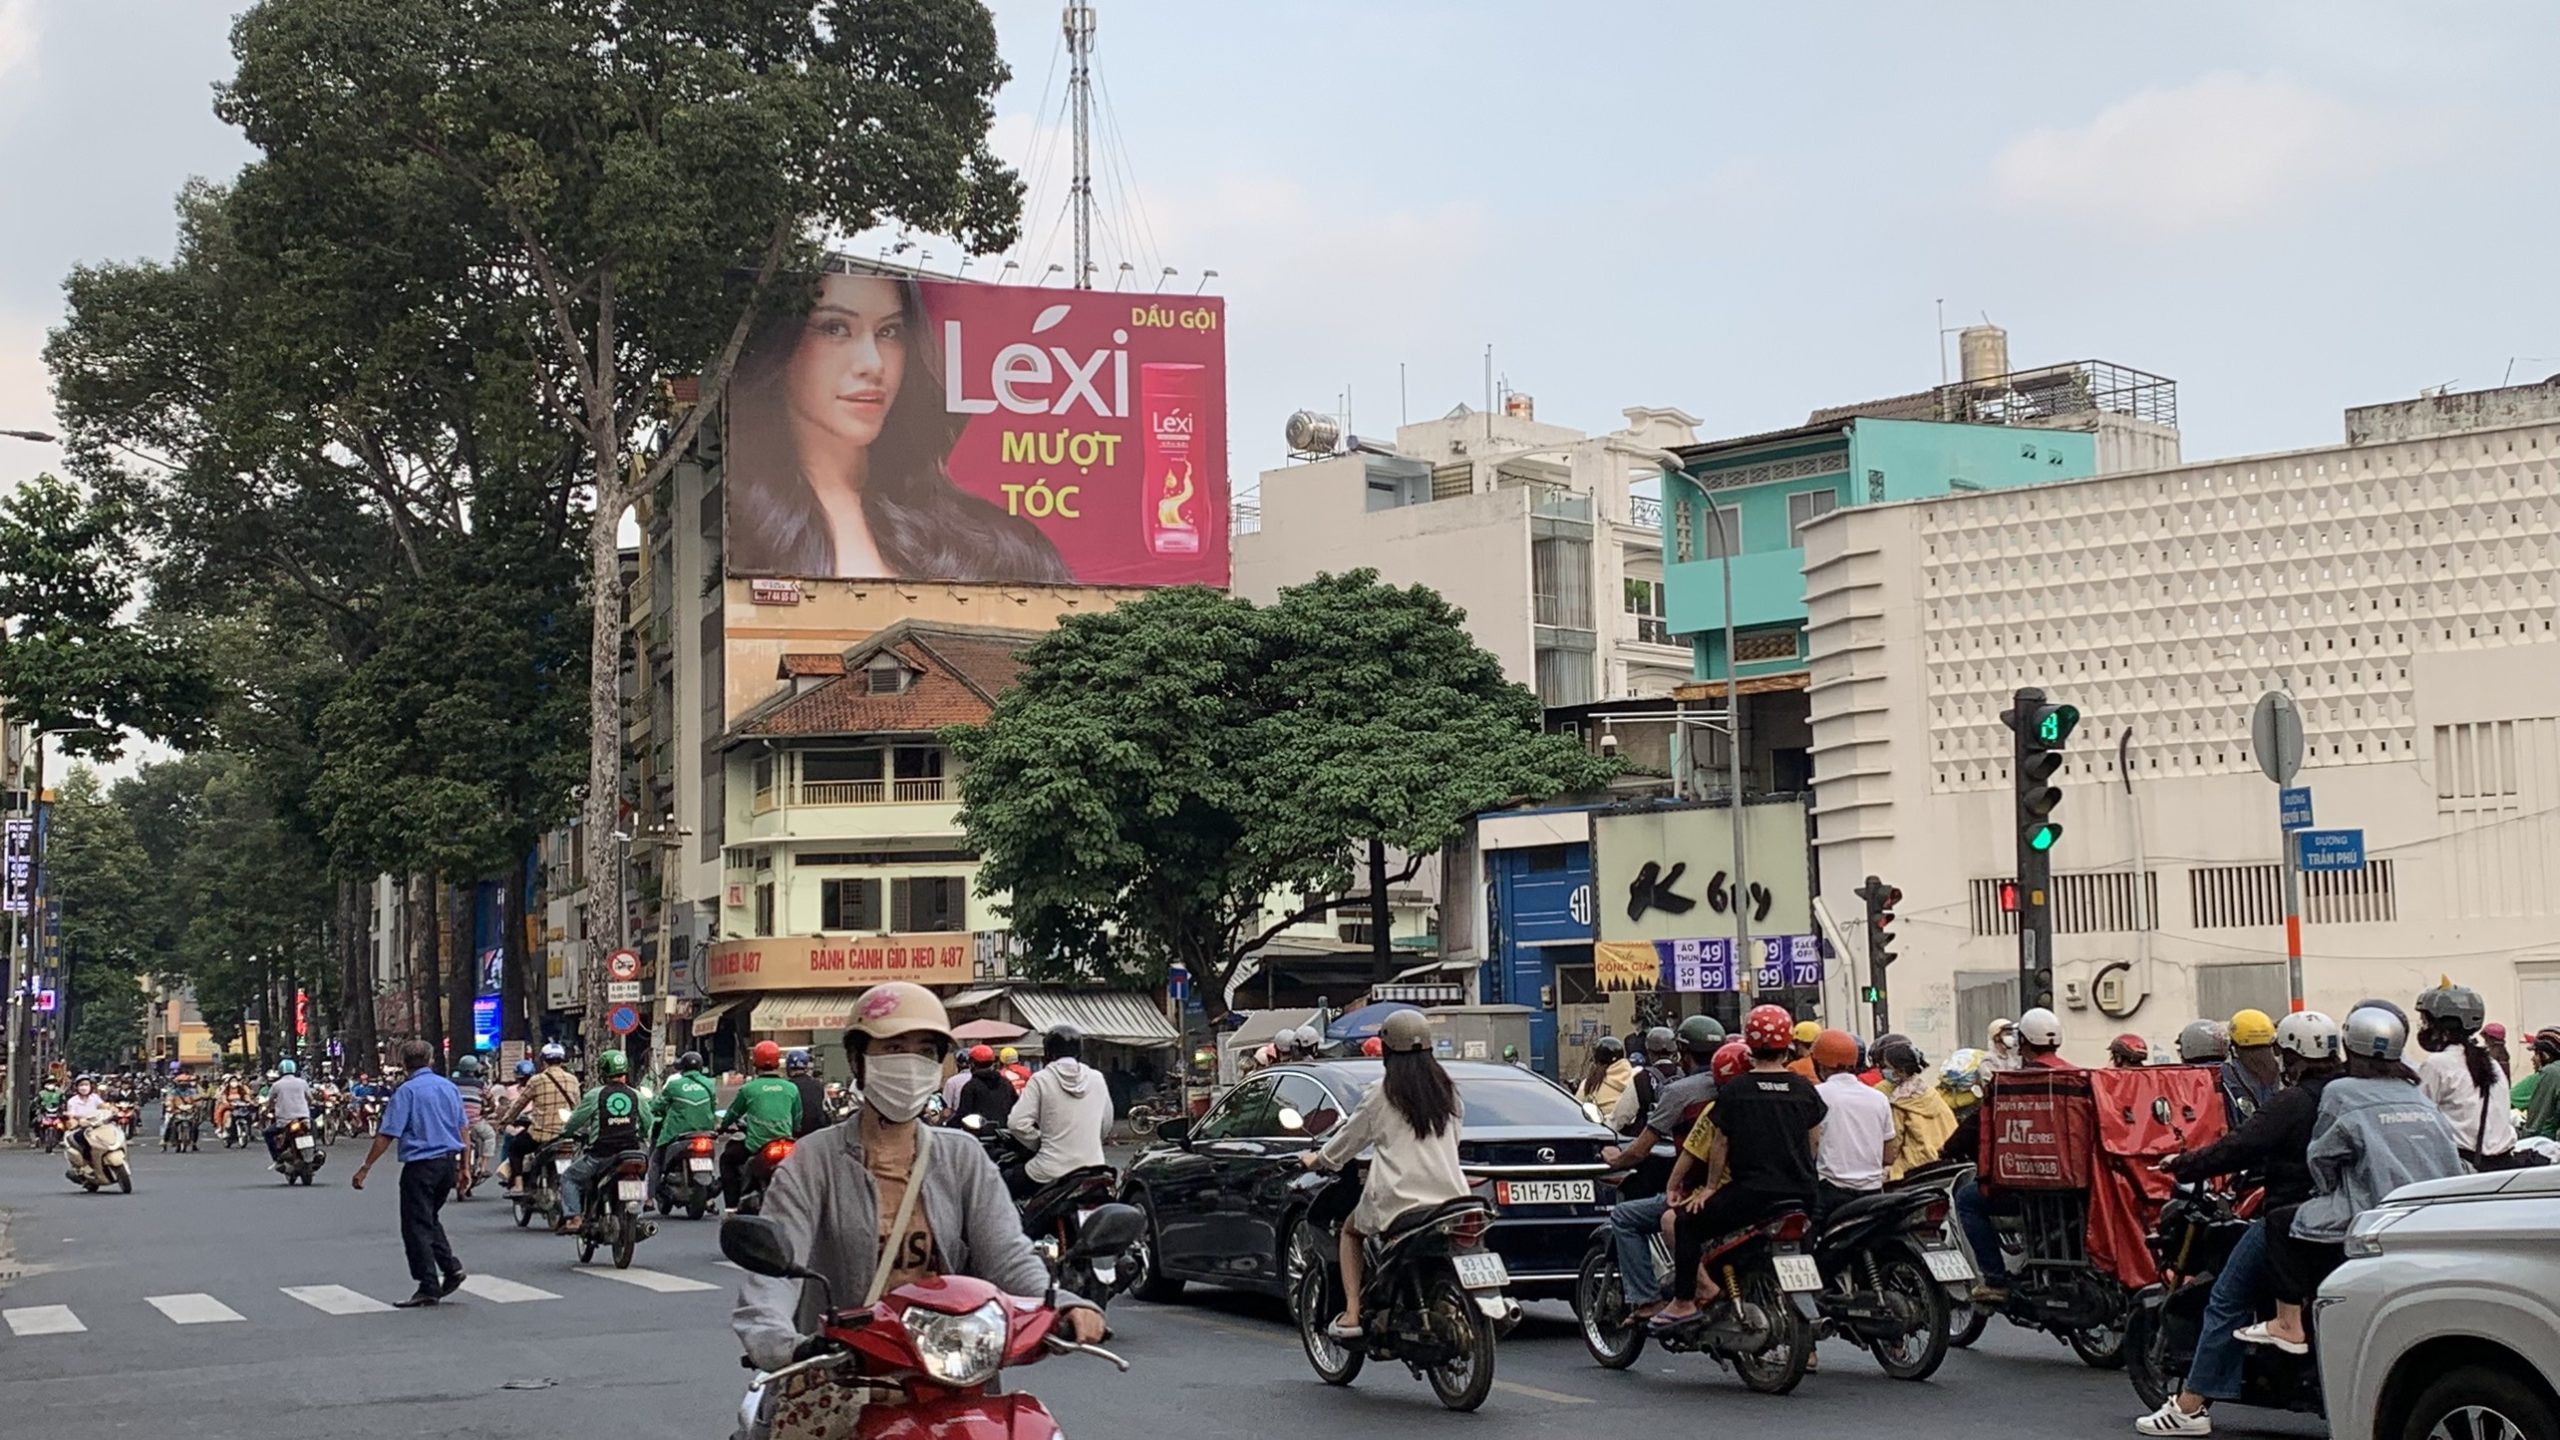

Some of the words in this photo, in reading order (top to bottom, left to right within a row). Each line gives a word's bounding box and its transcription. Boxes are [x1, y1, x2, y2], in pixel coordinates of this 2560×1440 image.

[1132, 304, 1174, 328] DẦU
[1180, 310, 1216, 335] GỘI
[944, 304, 1129, 417] Léxi
[1153, 408, 1193, 434] Léxi
[1002, 428, 1122, 474] MƯỢT
[1001, 478, 1080, 518] TÓC
[2336, 848, 2358, 865] PHÚ
[849, 948, 883, 970] CANH
[911, 947, 935, 968] HEO
[941, 946, 964, 968] 487
[1997, 1119, 2033, 1143] J&T
[1510, 1183, 1592, 1202] 51H-751.92
